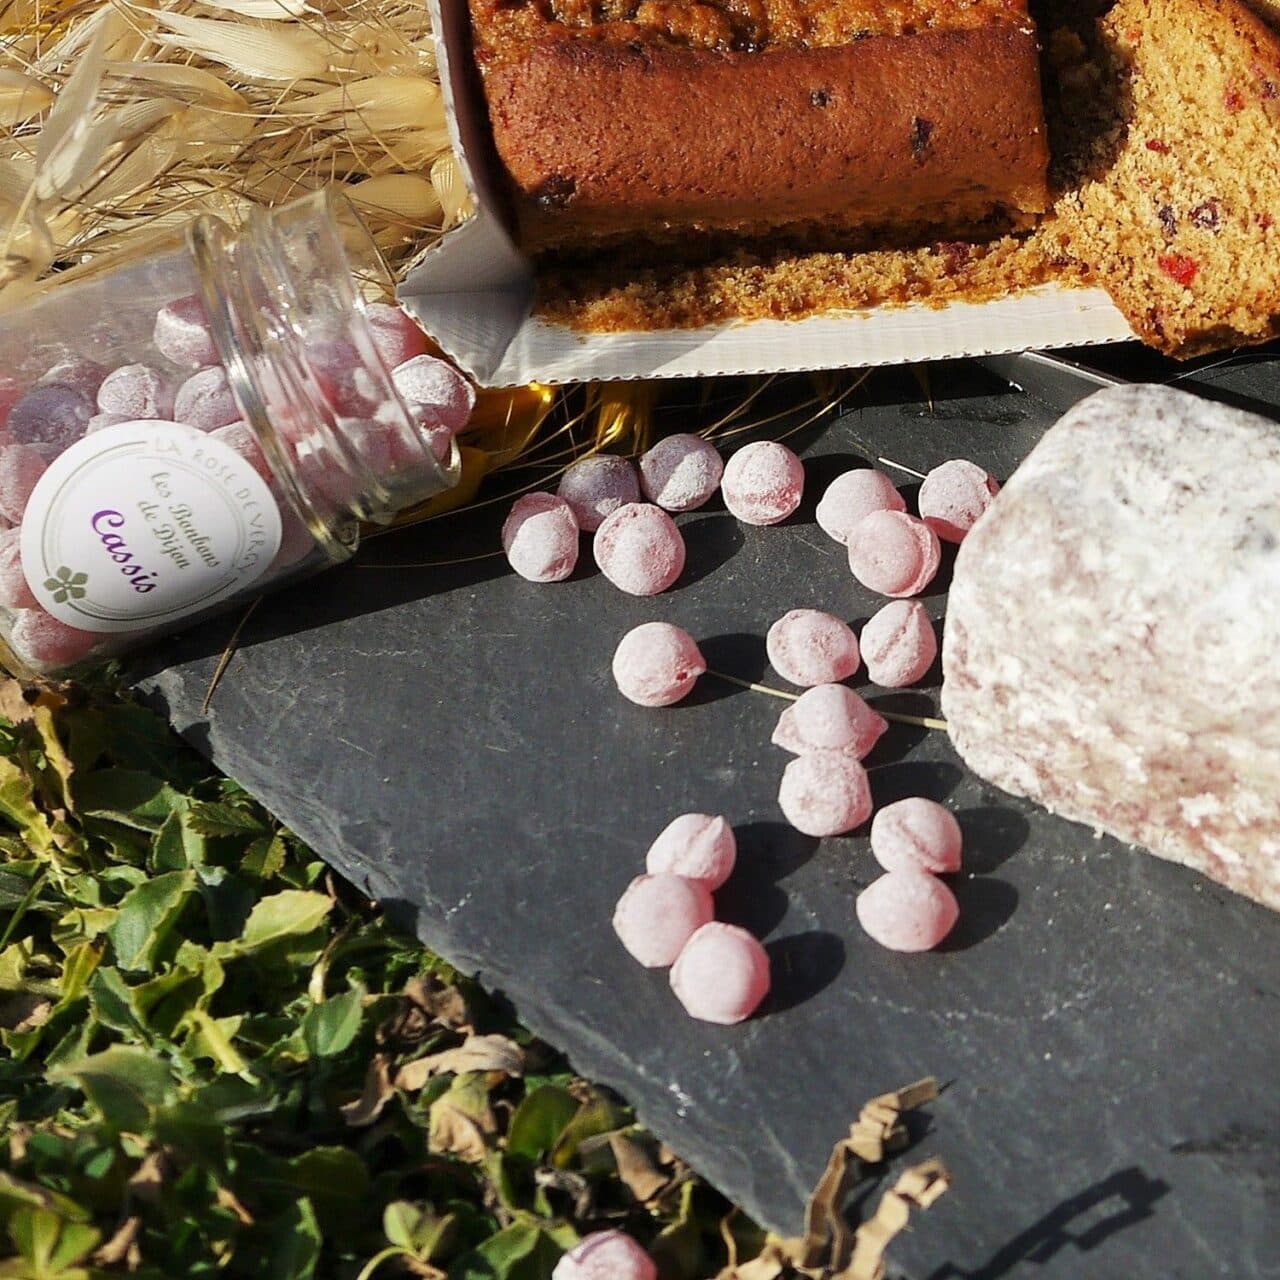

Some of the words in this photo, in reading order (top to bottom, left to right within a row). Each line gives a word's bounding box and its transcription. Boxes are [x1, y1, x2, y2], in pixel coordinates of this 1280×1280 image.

[91, 509, 161, 594] Cassis
[137, 500, 161, 523] de
[152, 523, 192, 570] Dijon
[168, 503, 221, 568] Bonbons
